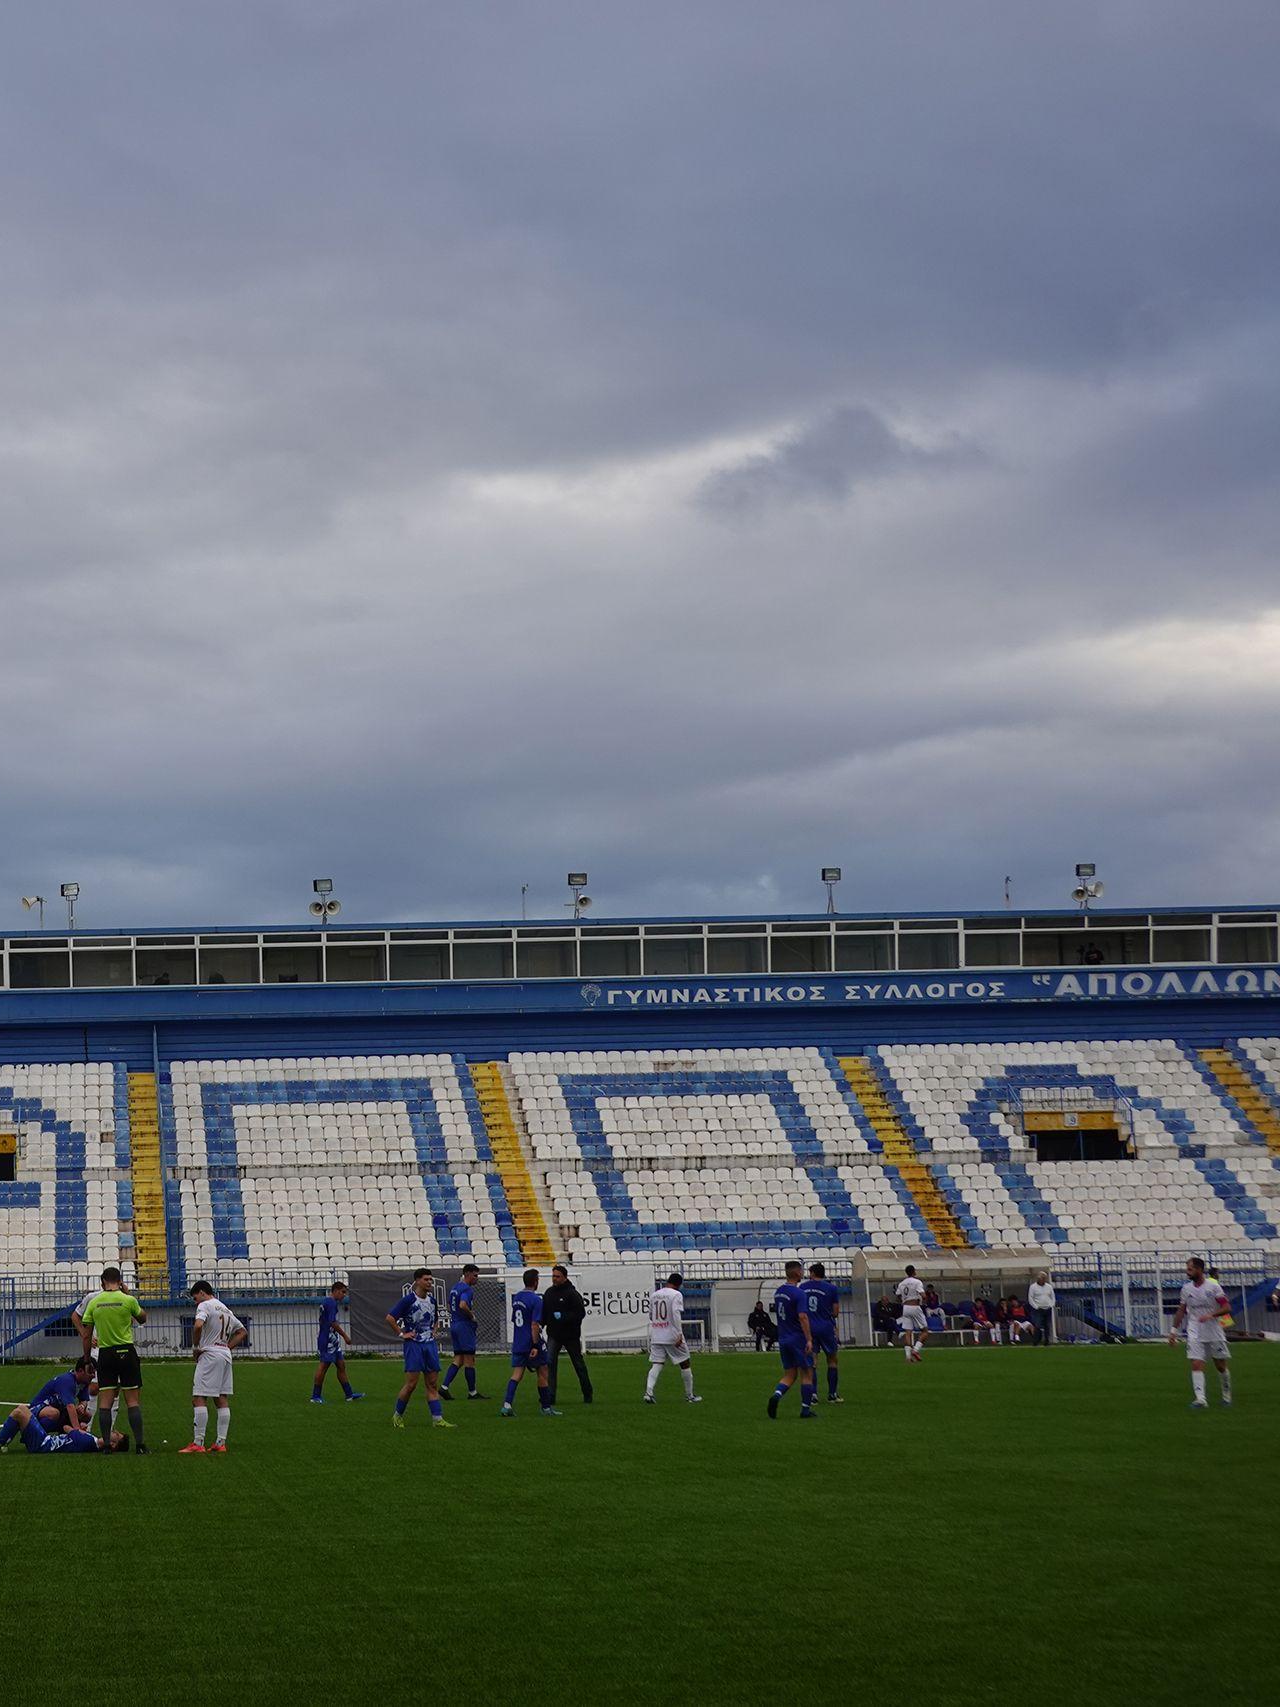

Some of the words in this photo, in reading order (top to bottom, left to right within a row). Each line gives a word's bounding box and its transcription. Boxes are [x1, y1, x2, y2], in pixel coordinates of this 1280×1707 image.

[607, 986, 827, 1005] ΓΥΜΝΑΣΤΙΚΟΣ
[845, 982, 1006, 1001] ΣΥΛΛΟΓΟΣ
[607, 1291, 650, 1300] BEACH
[808, 1295, 818, 1312] 9
[607, 1299, 650, 1315] CLUB
[654, 1300, 668, 1321] 10
[515, 1309, 524, 1328] 8
